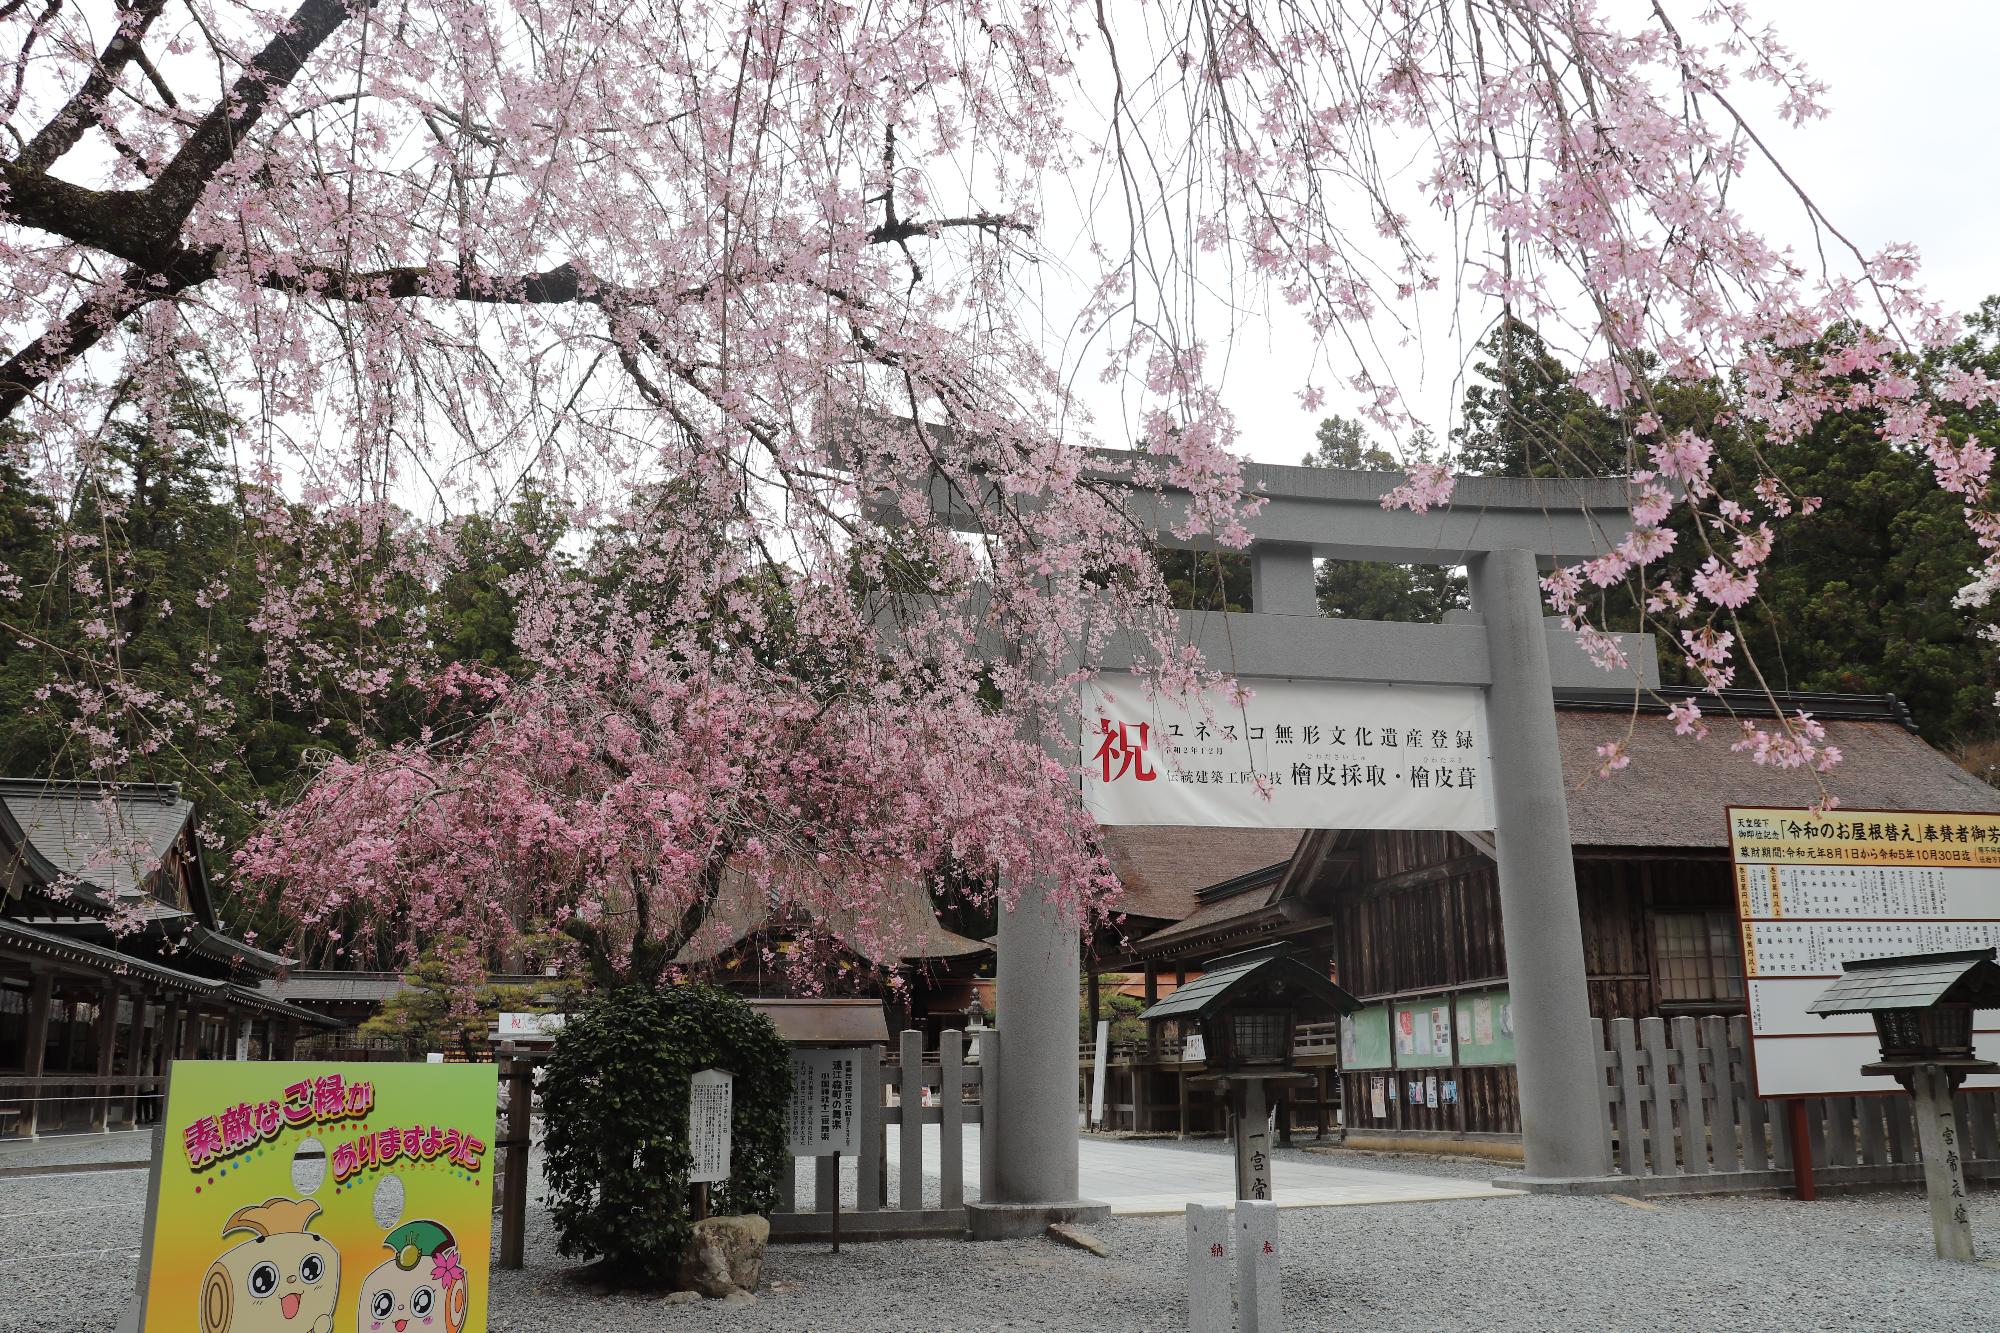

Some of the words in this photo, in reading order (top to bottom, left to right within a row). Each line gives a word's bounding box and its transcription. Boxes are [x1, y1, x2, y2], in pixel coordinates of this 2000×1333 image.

[1168, 722, 1475, 748] ユネスコ無形文化遺産登録
[1092, 717, 1155, 783] 祝
[1164, 746, 1224, 756] 令和2年12月
[1291, 763, 1477, 790] 檜皮採取・檜皮葺
[1737, 818, 1769, 829] 天皇陛下
[1738, 829, 1780, 841] 御即位記念
[184, 1073, 376, 1168] 素敵なご縁が
[332, 1126, 485, 1182] ありますように
[1210, 1243, 1224, 1257] 納
[1262, 1241, 1274, 1255] 奉
